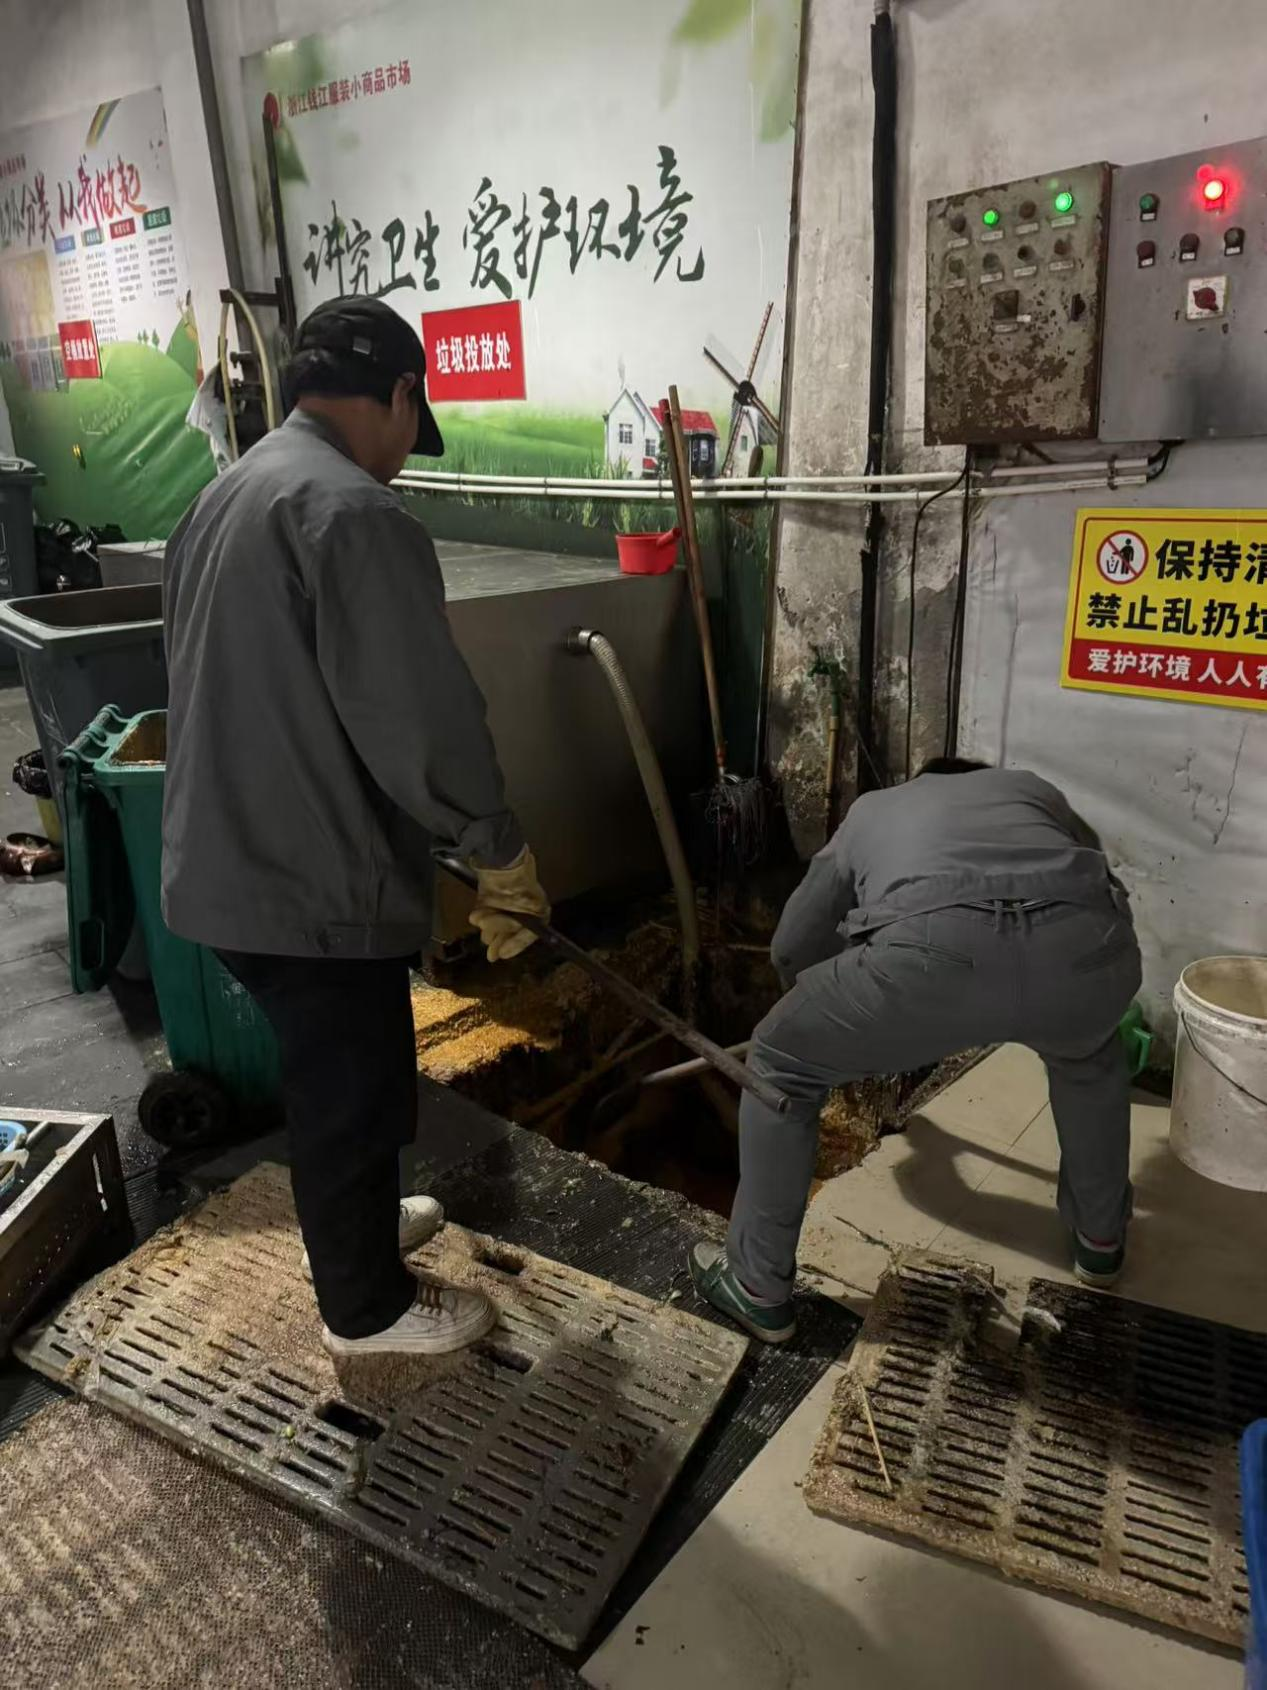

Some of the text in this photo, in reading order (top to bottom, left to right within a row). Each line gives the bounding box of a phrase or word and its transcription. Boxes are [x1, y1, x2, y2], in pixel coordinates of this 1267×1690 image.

[304, 200, 440, 298] 讲究卫生
[462, 145, 704, 299] 爱护环境
[436, 332, 512, 375] 垃圾投放处
[1087, 647, 1191, 682] 爱护环境
